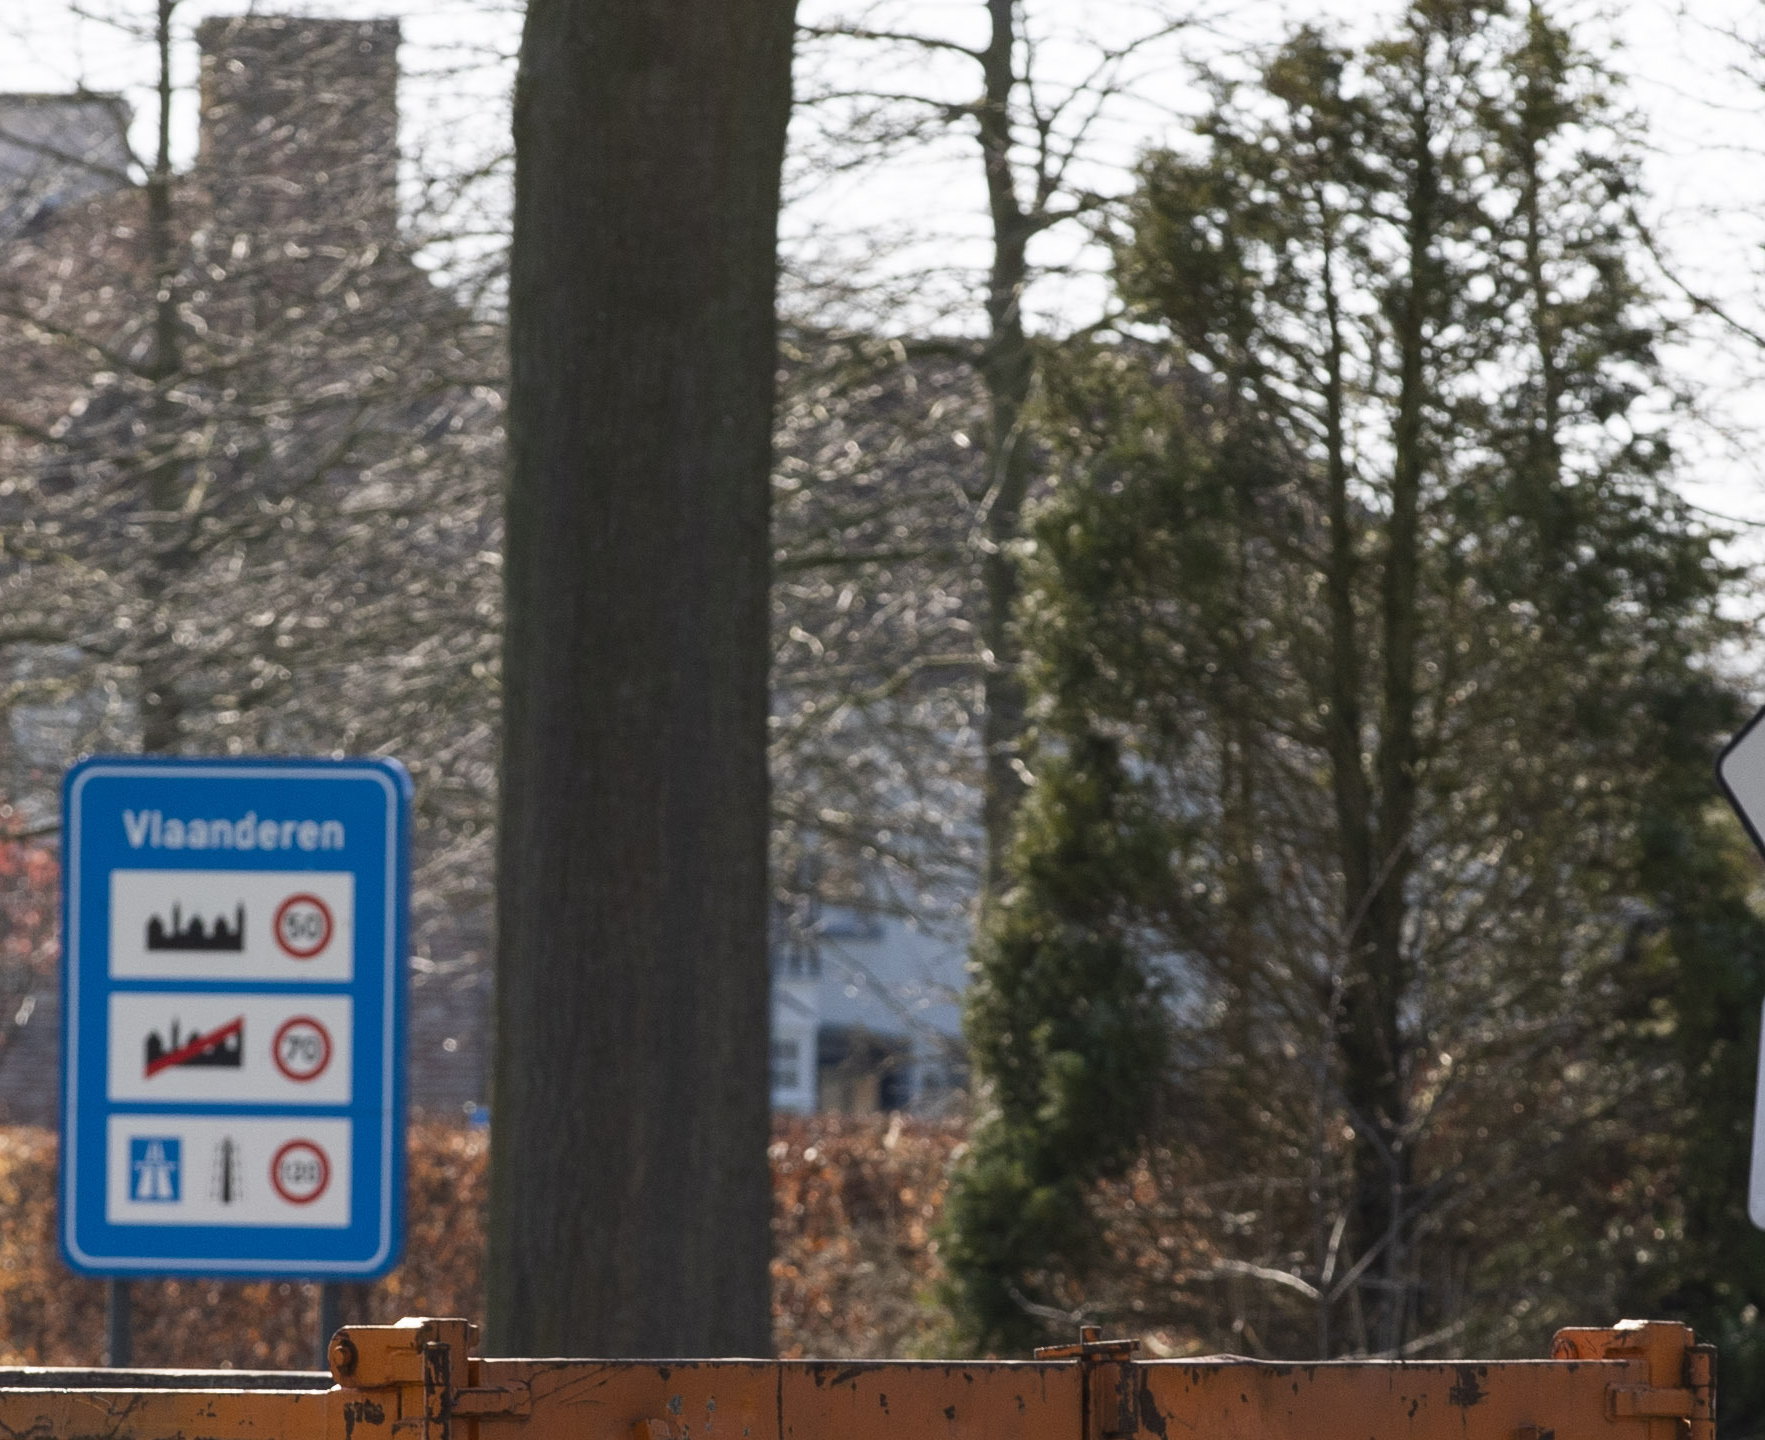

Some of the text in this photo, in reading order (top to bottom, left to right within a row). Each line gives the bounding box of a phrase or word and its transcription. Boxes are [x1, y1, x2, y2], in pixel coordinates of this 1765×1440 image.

[123, 810, 346, 852] Vlaanderen
[286, 912, 322, 941] 50
[286, 1035, 319, 1063] 70
